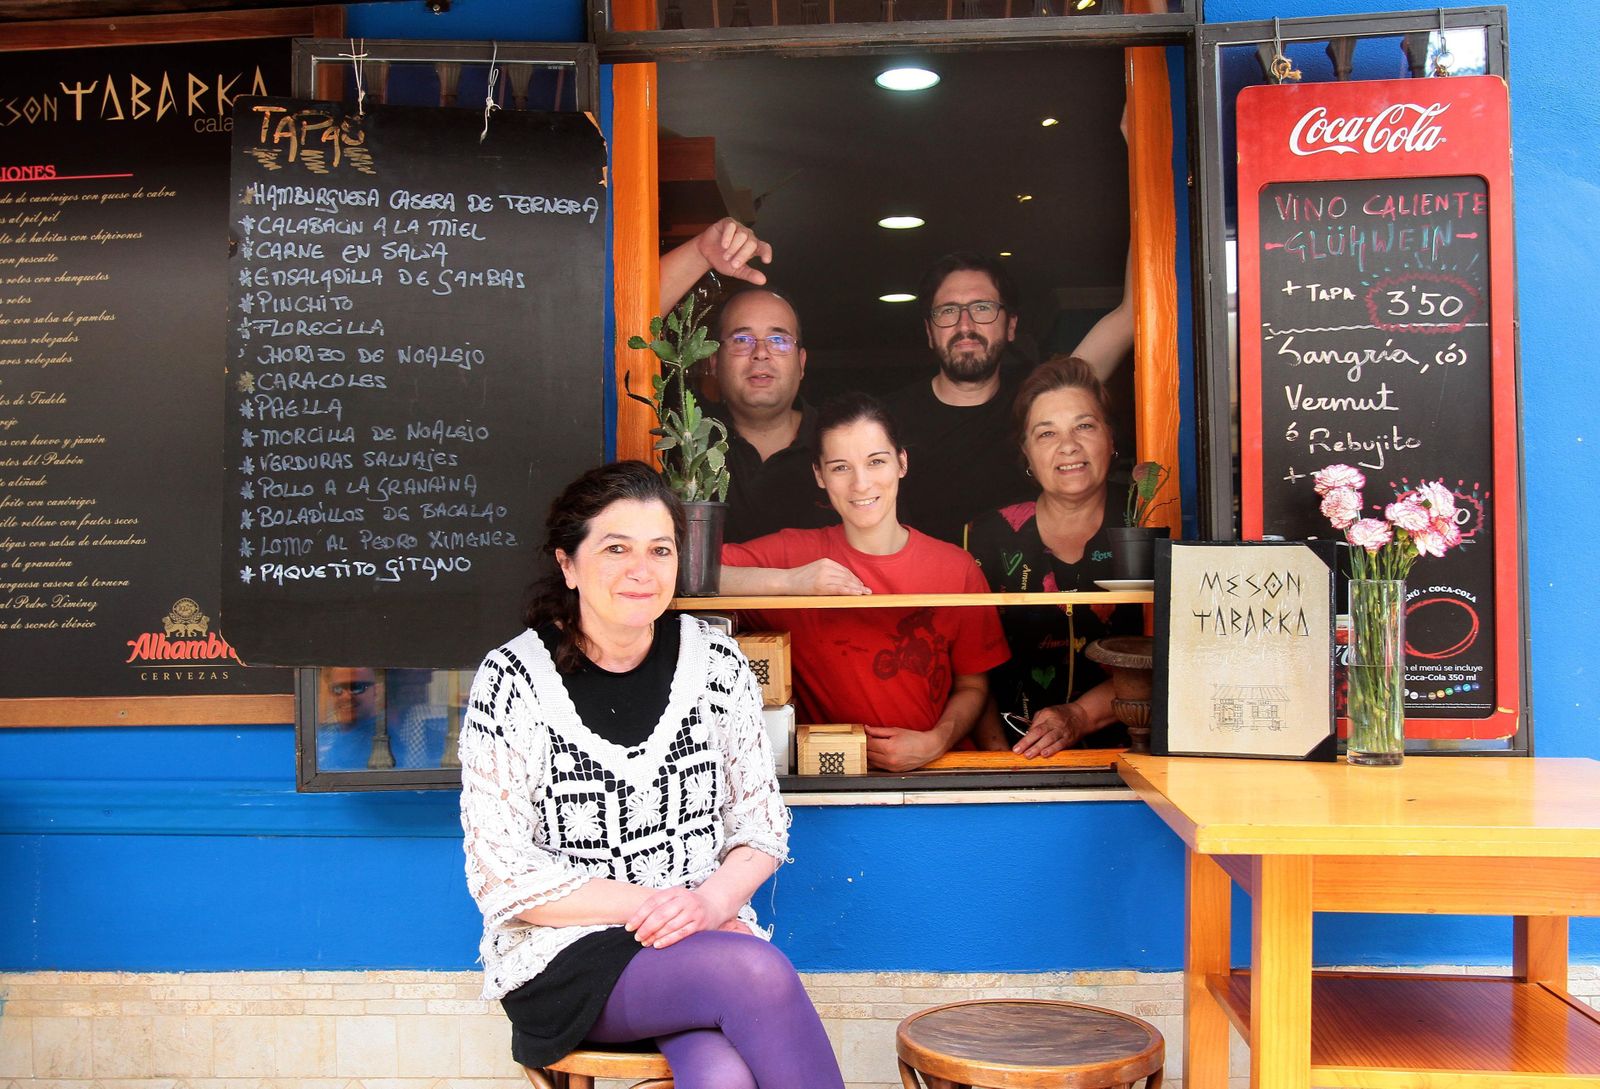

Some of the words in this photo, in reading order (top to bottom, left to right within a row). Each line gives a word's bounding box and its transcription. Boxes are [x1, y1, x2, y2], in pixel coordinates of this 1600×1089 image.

[0, 93, 57, 126] SON
[194, 115, 234, 132] cala
[0, 164, 57, 180] IONES
[254, 182, 379, 213] HAMBURGUESA
[467, 193, 494, 212] DE
[499, 194, 599, 224] TERNERA
[1275, 193, 1348, 222] VINO
[1362, 192, 1489, 221] CALIENTE
[90, 229, 143, 245] chipirones
[374, 216, 387, 237] A
[393, 219, 419, 235] LA
[427, 218, 486, 241] MIEL
[256, 241, 325, 261] CARNE
[342, 243, 371, 264] EN
[398, 268, 430, 287] DE
[432, 268, 526, 296] GAMBAS
[1305, 283, 1357, 302] TAPA
[256, 290, 353, 313] PINCHITO
[358, 348, 384, 364] DE
[257, 371, 388, 391] CARACOLES
[254, 393, 343, 422] PAELLA
[1285, 382, 1400, 412] Vermut
[371, 426, 397, 441] DE
[1309, 425, 1421, 470] Rebujito
[259, 452, 353, 472] VERDURAS
[257, 476, 314, 499] POLLO
[325, 479, 336, 496] A
[347, 476, 369, 495] LA
[383, 506, 410, 522] DE
[420, 502, 508, 523] BACALAO
[260, 536, 314, 557] LOMO
[326, 534, 348, 551] AL
[359, 529, 418, 550] PEDRO
[260, 558, 376, 587] PAQUETITO
[0, 582, 40, 593] urguesa
[1200, 571, 1301, 599] MESON
[1428, 586, 1477, 603] COCA-COLA
[13, 594, 48, 609] Pedro
[1192, 605, 1309, 638] TABARKA
[126, 632, 236, 663] Alhambr
[141, 672, 229, 681] CERVEZAS
[1455, 664, 1483, 672] incluye
